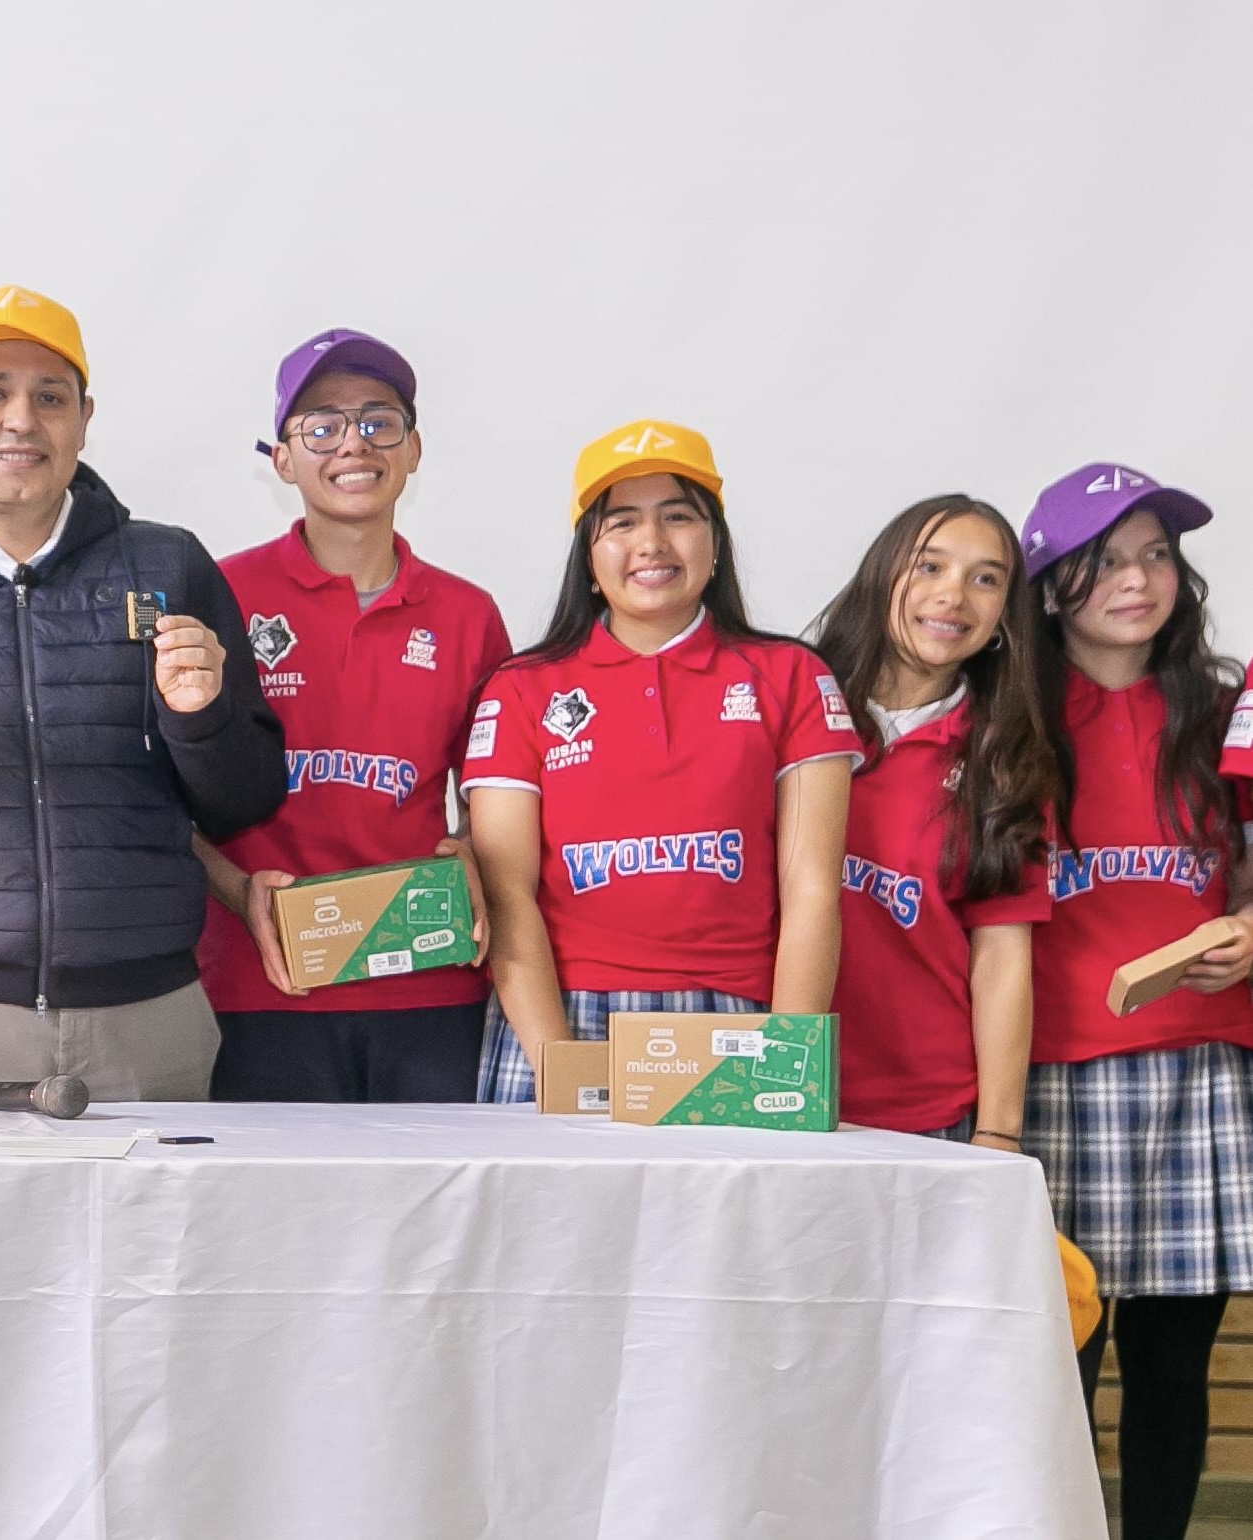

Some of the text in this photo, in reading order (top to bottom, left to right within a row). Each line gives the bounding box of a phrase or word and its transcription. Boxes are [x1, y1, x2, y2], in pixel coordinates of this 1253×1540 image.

[262, 686, 297, 697] AYER
[561, 828, 744, 895] WOLVES
[841, 853, 923, 930] VES
[299, 920, 363, 941] micro:bit
[418, 933, 449, 948] CLUB
[626, 1058, 699, 1075] micro:bit
[761, 1097, 797, 1108] CLUB
